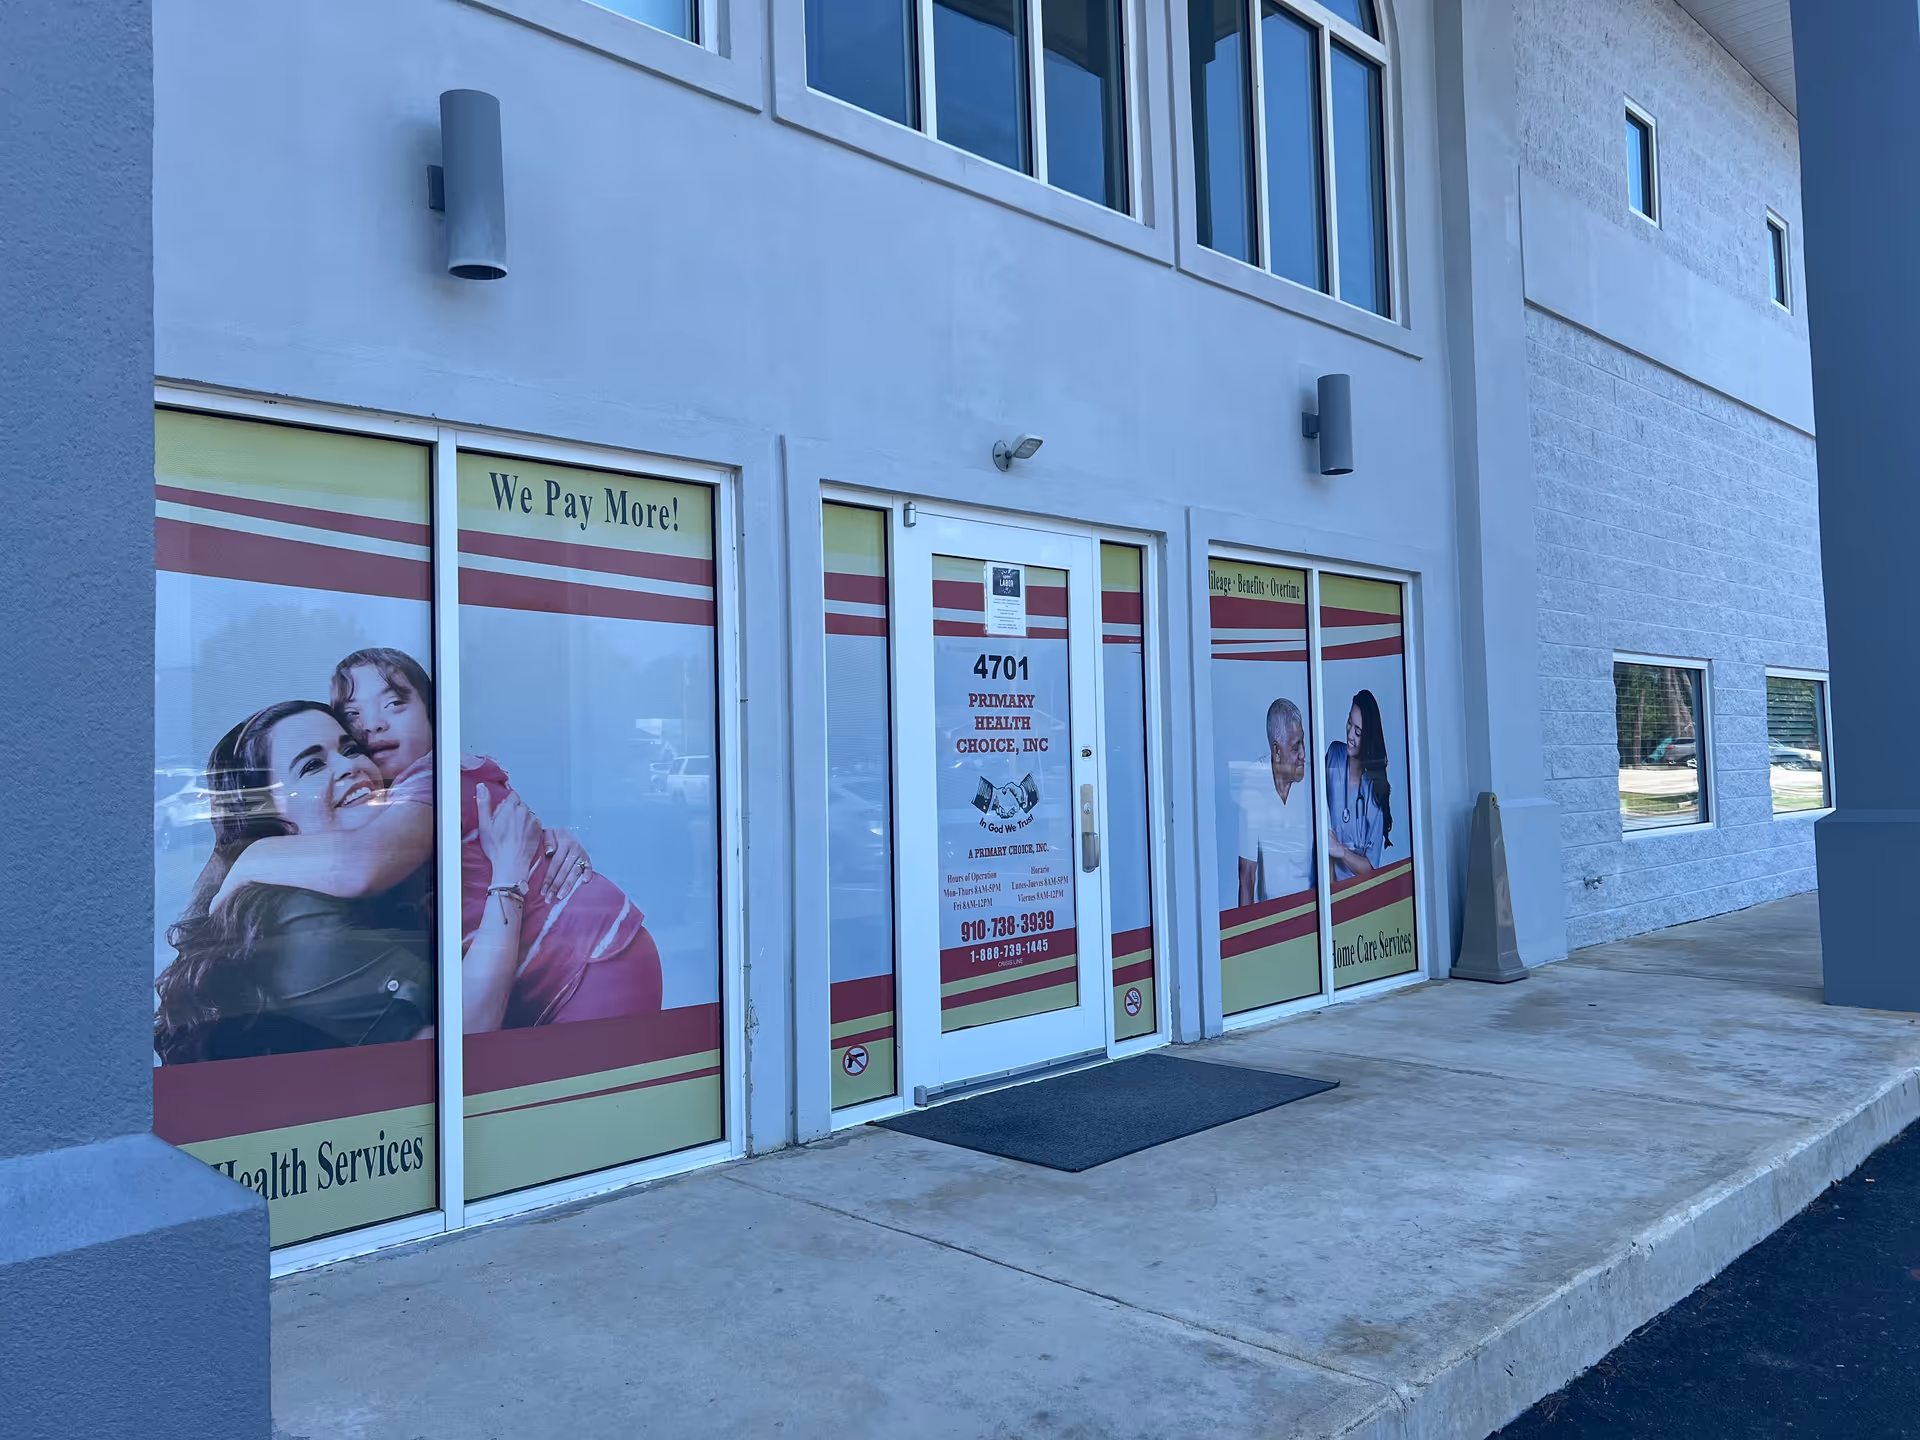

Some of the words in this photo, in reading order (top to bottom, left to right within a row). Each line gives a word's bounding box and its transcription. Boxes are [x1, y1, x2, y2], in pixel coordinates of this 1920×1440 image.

[488, 472, 533, 514] We
[544, 479, 593, 531] Pay
[604, 487, 679, 532] More!
[1208, 569, 1231, 597] ileage
[1237, 573, 1265, 595] Benefits
[1270, 577, 1300, 599] Overtime
[973, 654, 1029, 681] 4701
[968, 693, 1035, 708] PRIMARY
[974, 716, 1031, 730] HEALTH
[956, 738, 1020, 755] CHOICE,
[1022, 737, 1049, 752] INC
[979, 817, 987, 829] In
[988, 823, 1004, 834] God
[1005, 824, 1017, 833] We
[1017, 813, 1034, 829] Trust
[968, 849, 973, 859] A
[974, 846, 1007, 858] PRIMARY
[1008, 844, 1035, 855] CHOICE,
[1036, 842, 1049, 853] INC.
[947, 874, 964, 883] Hours
[964, 872, 971, 881] of
[971, 871, 997, 883] Operation
[1011, 879, 1044, 890] Lunes-Jueves
[1044, 875, 1069, 886] 8AM-5PM
[943, 887, 974, 897] Mon-Thurs
[974, 883, 1001, 893] 8AM-5PM
[1017, 893, 1036, 902] Viernes
[1036, 889, 1064, 900] 8AM-12PM
[953, 901, 962, 911] Fri
[962, 897, 993, 910] 8AM-12PM
[970, 939, 1048, 963] 1-888-739-1445
[1356, 934, 1378, 964] Care
[1378, 927, 1412, 959] Services
[1013, 957, 1024, 965] LINE
[210, 1147, 308, 1200] alth
[317, 1129, 424, 1191] Services
